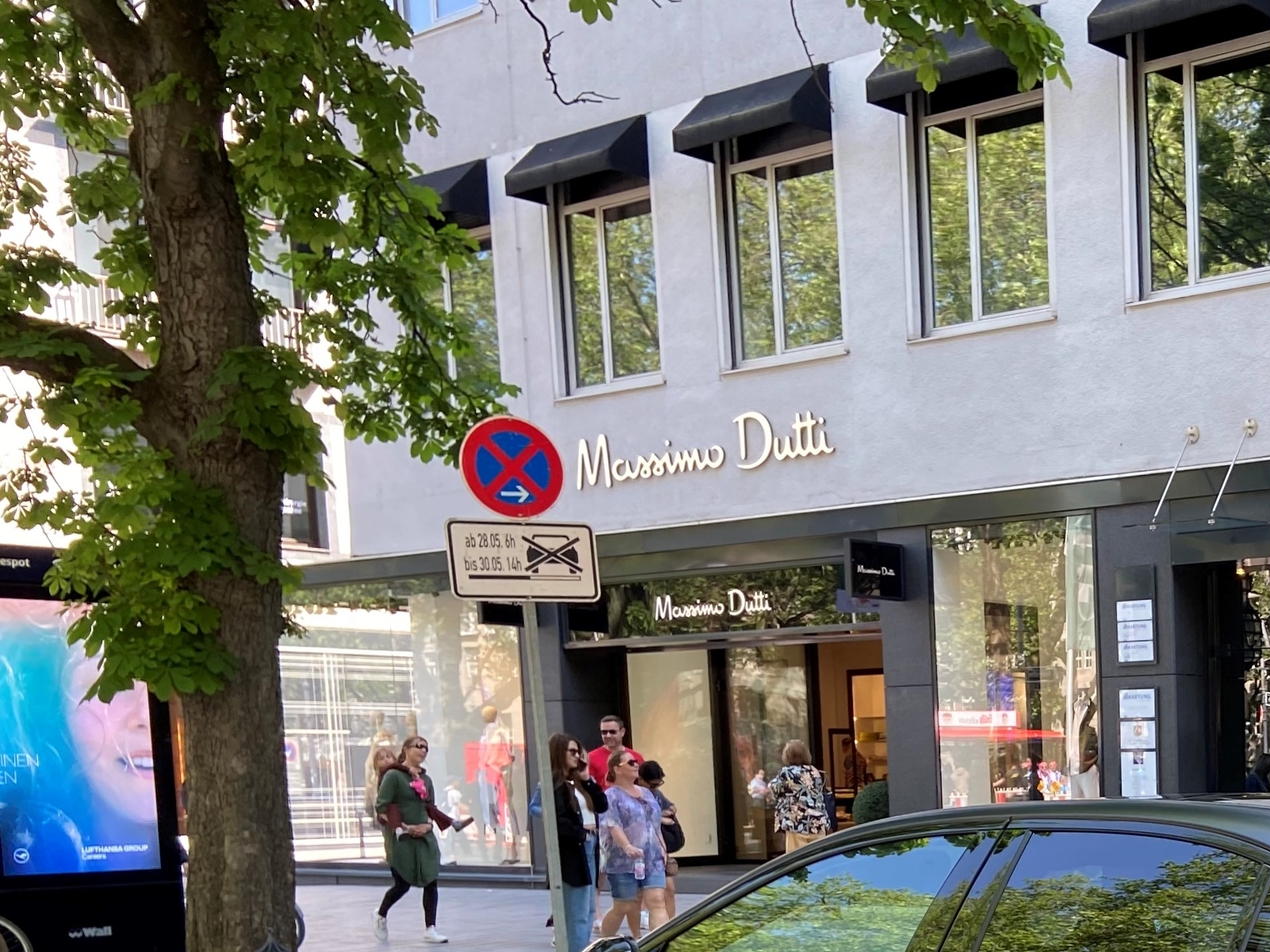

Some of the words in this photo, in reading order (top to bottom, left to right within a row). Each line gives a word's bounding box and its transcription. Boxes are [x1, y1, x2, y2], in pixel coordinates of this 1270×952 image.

[577, 433, 725, 491] Massimo
[732, 410, 836, 470] Dutti
[465, 533, 477, 548] ab
[477, 533, 504, 548] 28.05.
[504, 534, 516, 548] 6h
[464, 557, 478, 571] bis
[479, 557, 505, 571] 30.05.
[506, 557, 522, 571] 14h
[857, 564, 881, 574] Massimo
[881, 566, 896, 576] Dutti
[655, 594, 725, 621] Massimo
[727, 588, 772, 616] Dutti
[81, 845, 124, 854] LUFTHANSA
[123, 844, 149, 852] GROUP
[82, 925, 112, 937] Wall
